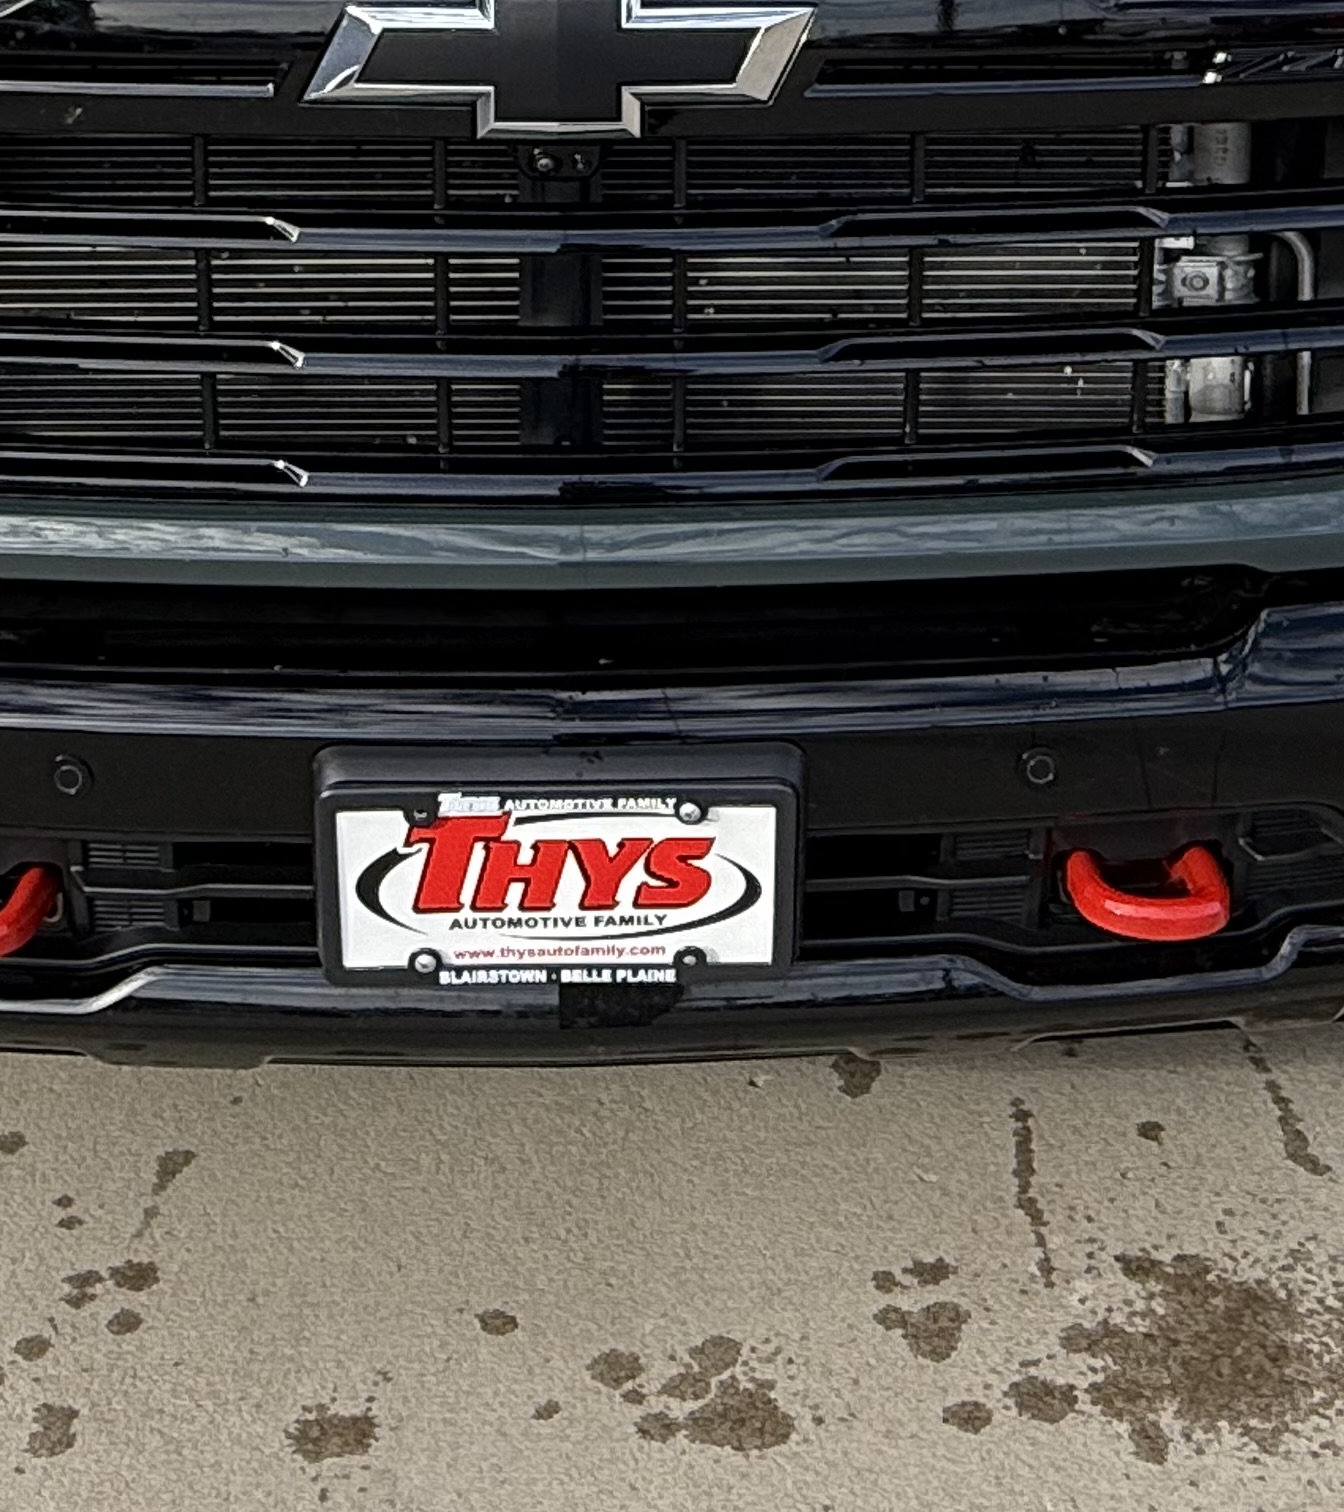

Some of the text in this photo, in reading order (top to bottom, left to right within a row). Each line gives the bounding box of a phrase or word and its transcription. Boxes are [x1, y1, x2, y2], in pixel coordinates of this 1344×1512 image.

[503, 798, 613, 812] AUTOMOTIVE
[616, 797, 677, 812] FAMILY
[403, 812, 717, 915] THYS
[448, 913, 668, 931] AUTOMOTIVE FAMILY
[452, 943, 667, 961] www.thysautofamily.com
[438, 967, 677, 985] BLAIRSTOWN BELLE PLAINE
